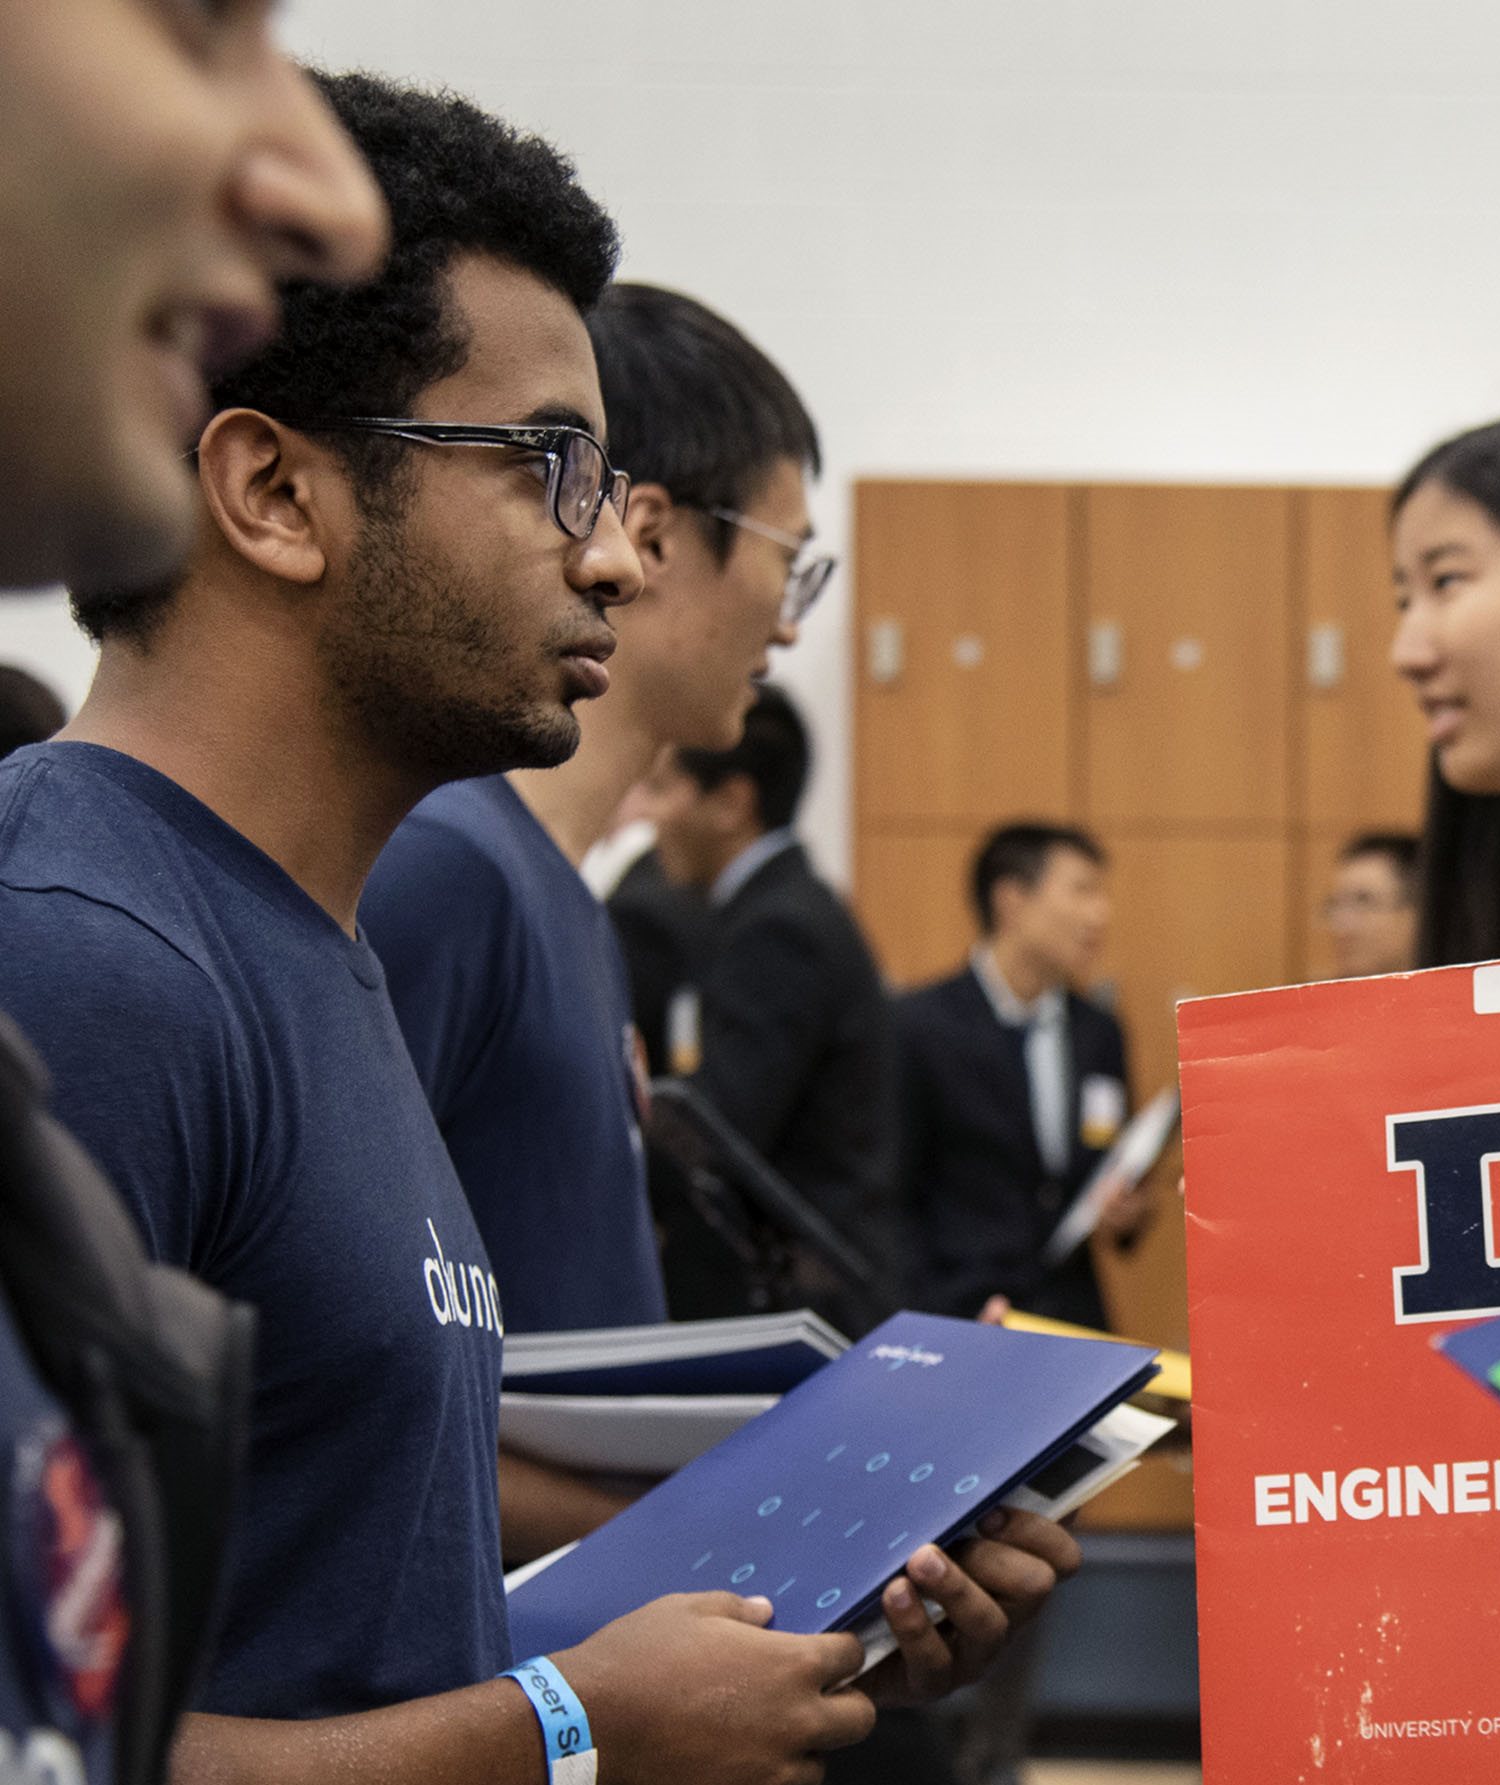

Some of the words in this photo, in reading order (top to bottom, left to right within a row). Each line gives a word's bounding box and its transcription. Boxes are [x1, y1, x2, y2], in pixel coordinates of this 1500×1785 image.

[519, 1663, 569, 1716] reer
[557, 1726, 581, 1758] S
[1360, 1718, 1472, 1740] UNIVERSITY
